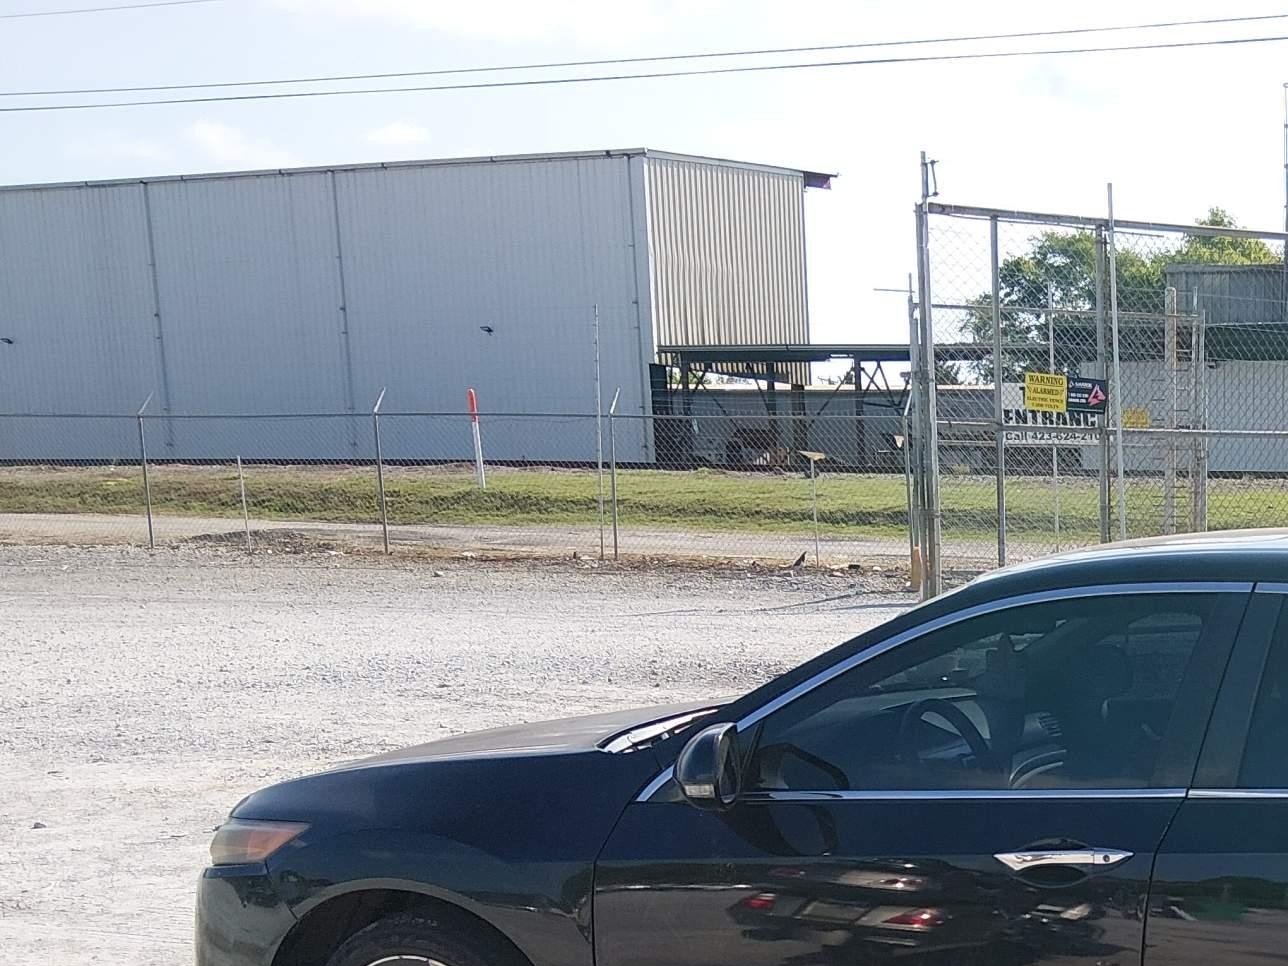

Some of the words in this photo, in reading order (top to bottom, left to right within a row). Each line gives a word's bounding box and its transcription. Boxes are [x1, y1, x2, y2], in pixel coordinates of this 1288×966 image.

[1028, 375, 1064, 386] WARNING
[1032, 387, 1059, 396] ALARMED
[1002, 409, 1099, 427] ENTRANC
[1005, 431, 1027, 441] Call
